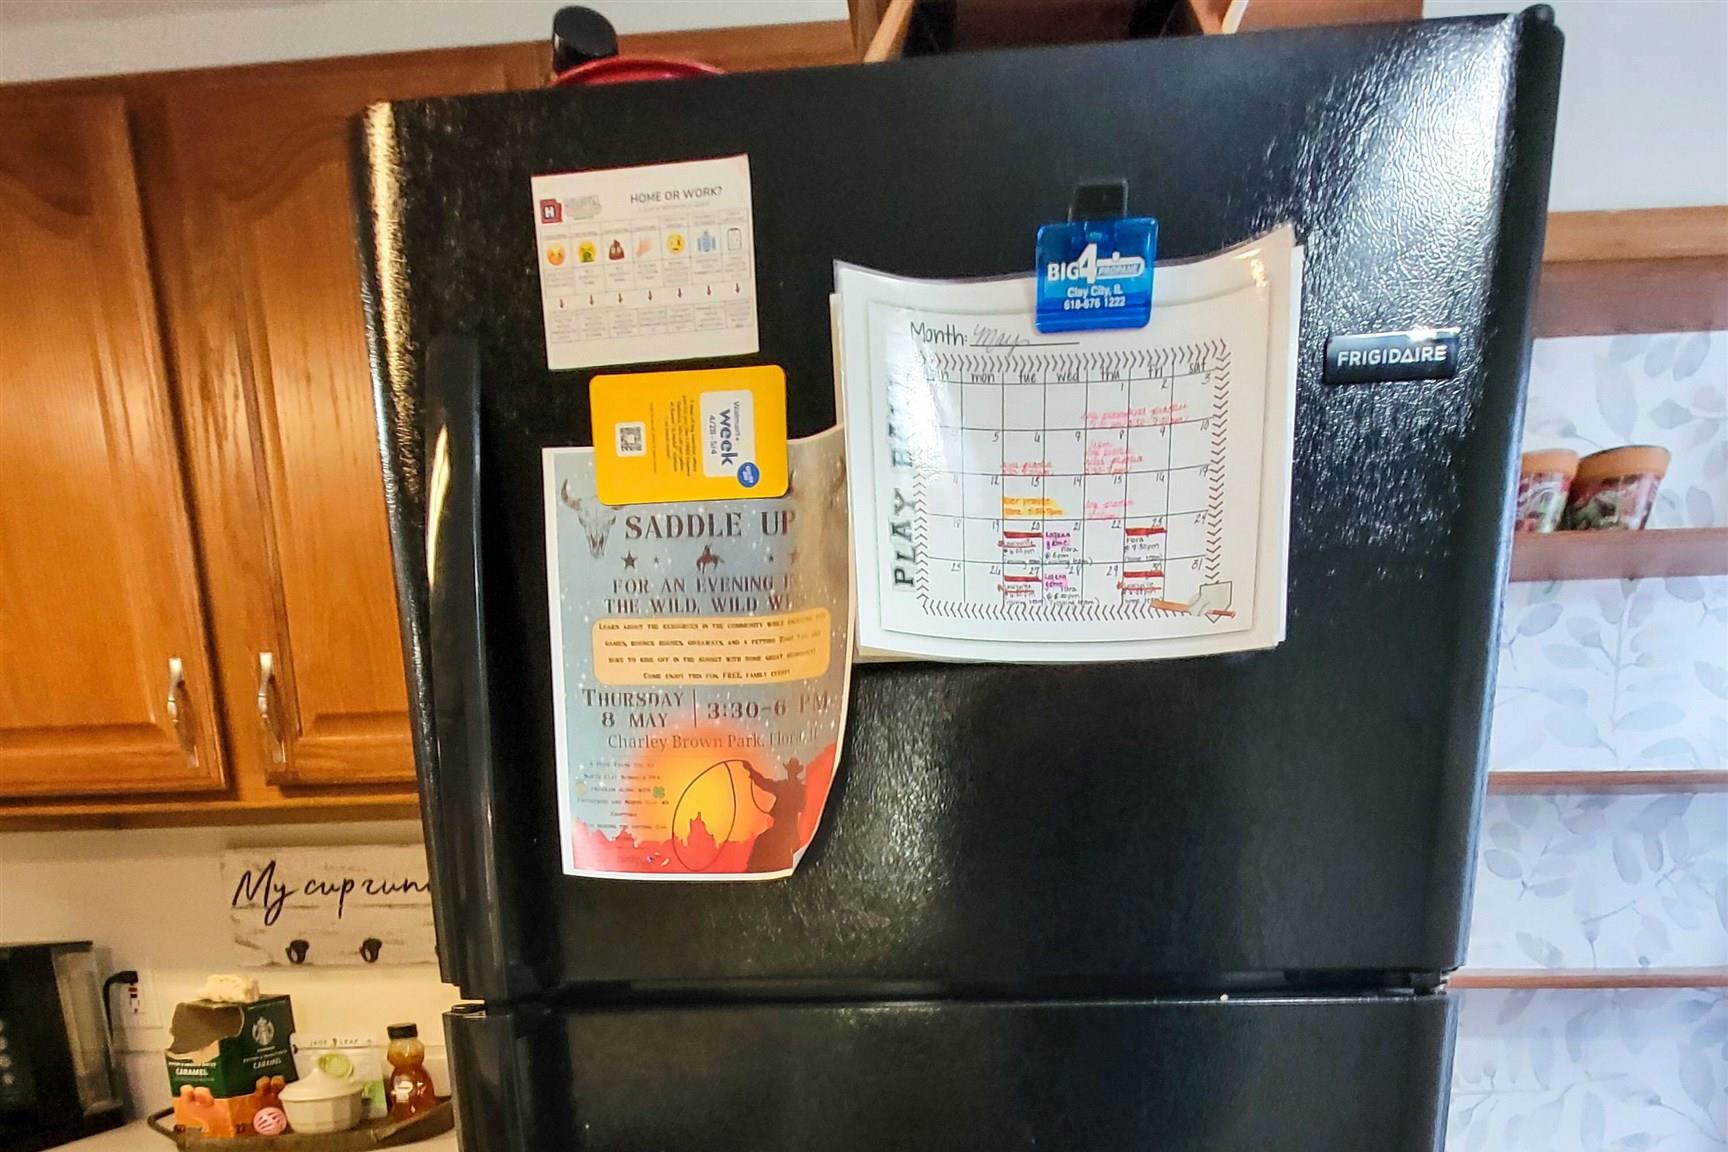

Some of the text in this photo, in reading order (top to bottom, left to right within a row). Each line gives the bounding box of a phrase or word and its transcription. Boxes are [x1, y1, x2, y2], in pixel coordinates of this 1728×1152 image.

[630, 186, 723, 204] HOME OR WORK?
[1048, 243, 1098, 284] BIG 4
[1068, 286, 1089, 299] Clay
[1091, 285, 1112, 298] City,
[1104, 296, 1126, 308] 1222
[910, 321, 968, 346] Month:
[1337, 345, 1448, 366] FRIGIDAIRE
[720, 409, 738, 466] week
[625, 510, 796, 540] SADDLE UP
[892, 488, 916, 587] PLAY
[612, 577, 650, 594] FOR
[661, 577, 686, 592] AN
[697, 576, 774, 593] EVENING
[604, 599, 640, 614] THE
[650, 598, 700, 614] WILD,
[712, 598, 758, 613] WILD
[582, 688, 685, 708] THURSDAY
[601, 711, 668, 728] 8 MAY
[708, 699, 787, 720] 3:30-6
[608, 734, 666, 752] Charley
[672, 734, 723, 749] Brown
[728, 732, 764, 748] Park,
[232, 859, 300, 926] My
[304, 877, 356, 920] cup
